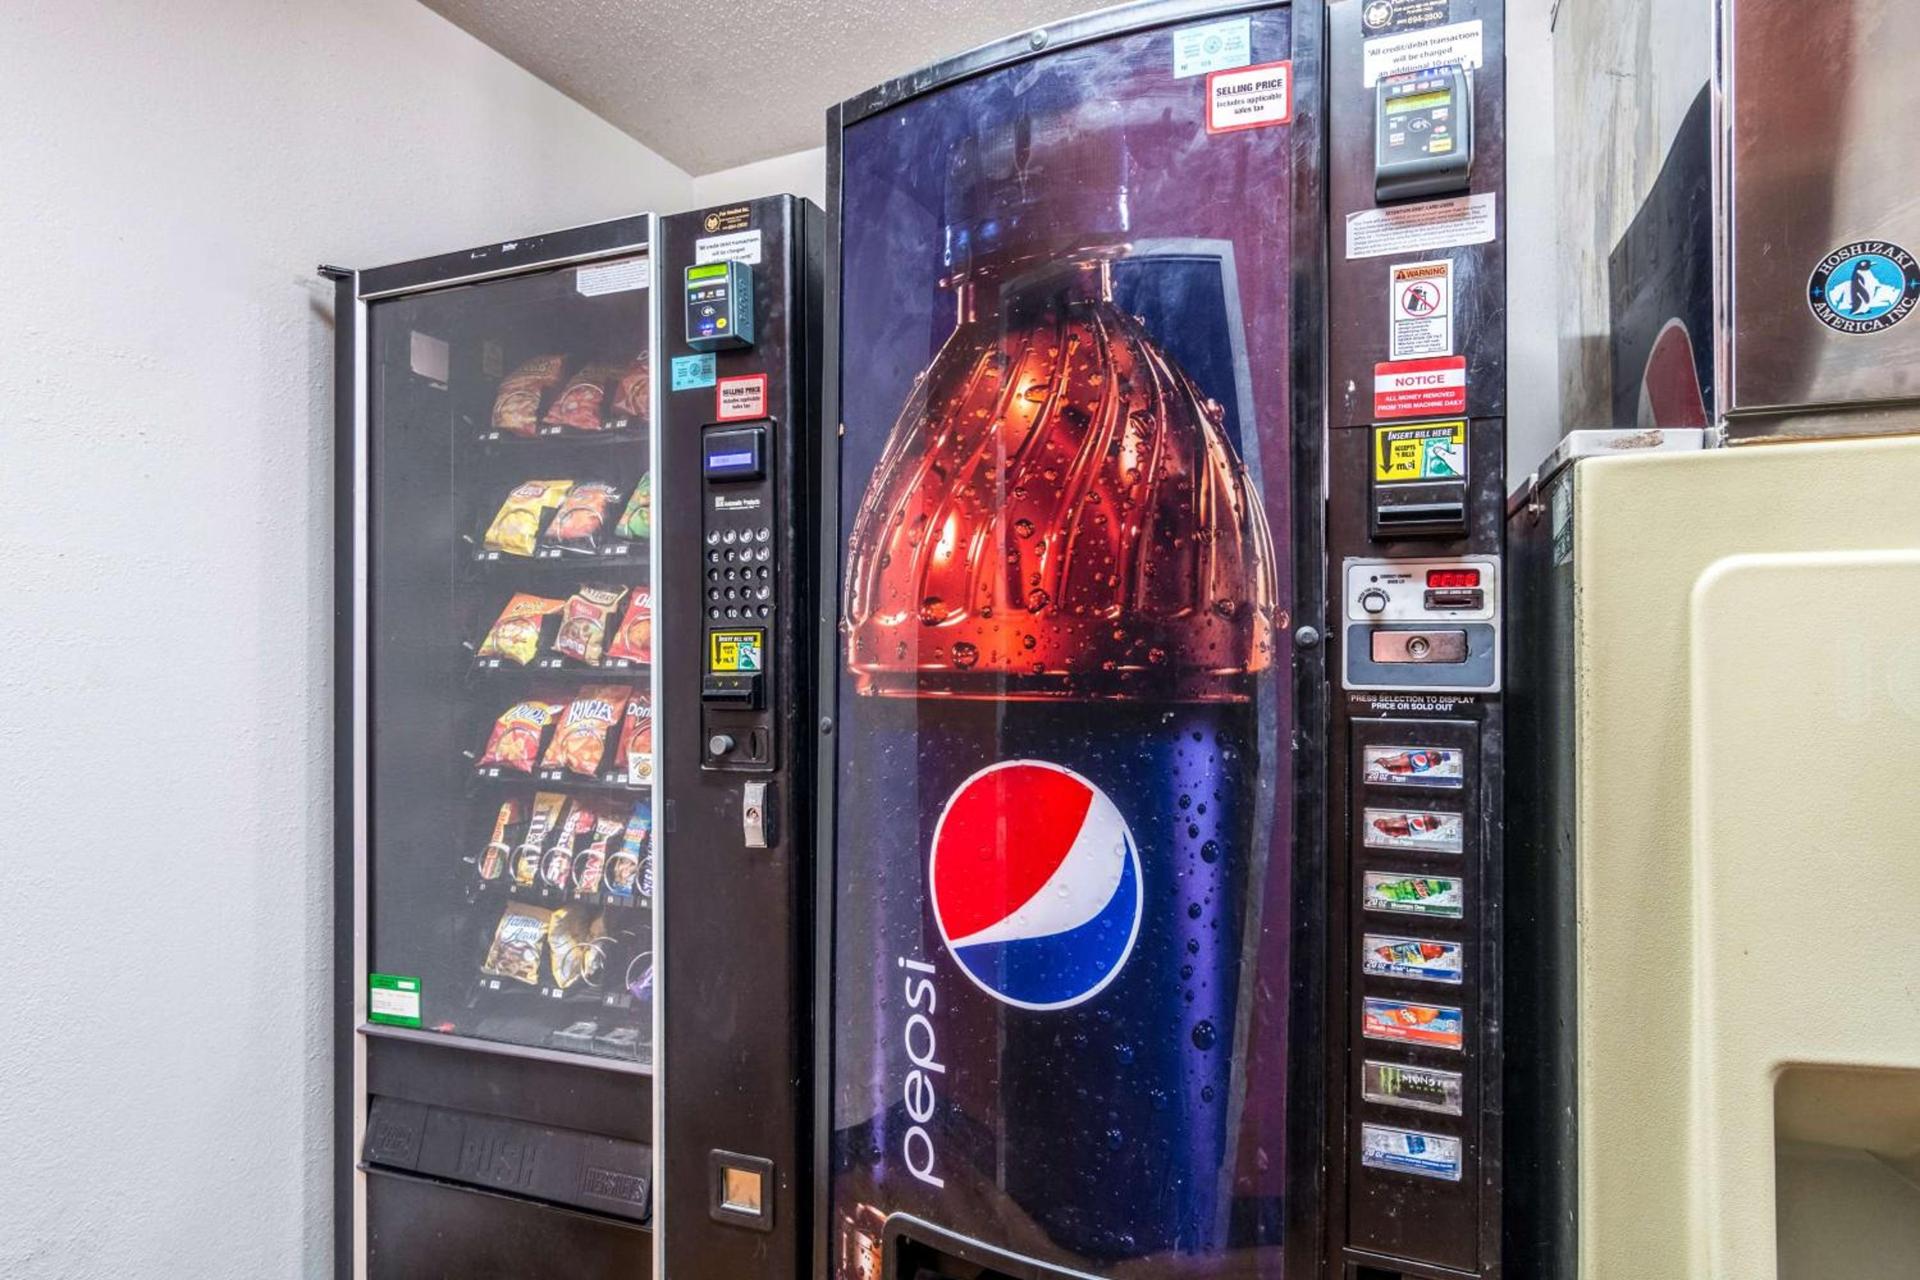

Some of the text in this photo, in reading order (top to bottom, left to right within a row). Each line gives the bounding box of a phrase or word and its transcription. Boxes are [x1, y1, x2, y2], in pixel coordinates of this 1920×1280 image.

[1430, 31, 1479, 46] transactions
[1393, 46, 1453, 63] will be charged
[1216, 78, 1284, 97] SELLING PRICE
[1216, 92, 1283, 109] Includes applicable
[1234, 104, 1265, 115] sales tax
[1818, 243, 1915, 276] HOSHIZAKI
[1405, 266, 1446, 279] WARNING
[1395, 374, 1445, 387] NOTICE
[1398, 393, 1421, 401] MONEY
[1423, 391, 1456, 399] REMOVED
[1397, 402, 1413, 410] THIS
[1413, 400, 1443, 409] MACHINE
[1443, 399, 1465, 407] DAILY
[1388, 428, 1453, 441] INSERT BILL HERE
[712, 553, 719, 562] E
[729, 552, 735, 561] F
[713, 569, 768, 581] 1 2 3 4
[713, 591, 719, 600] 5
[729, 590, 735, 599] 6
[745, 589, 751, 598] 7
[713, 609, 738, 619] 9 10
[1379, 695, 1424, 703] SELECTION
[1425, 695, 1437, 703] TO
[1439, 696, 1475, 704] DISPLAY
[1371, 702, 1454, 711] PRICE OR SOLD OUT
[898, 956, 945, 1188] pepsi
